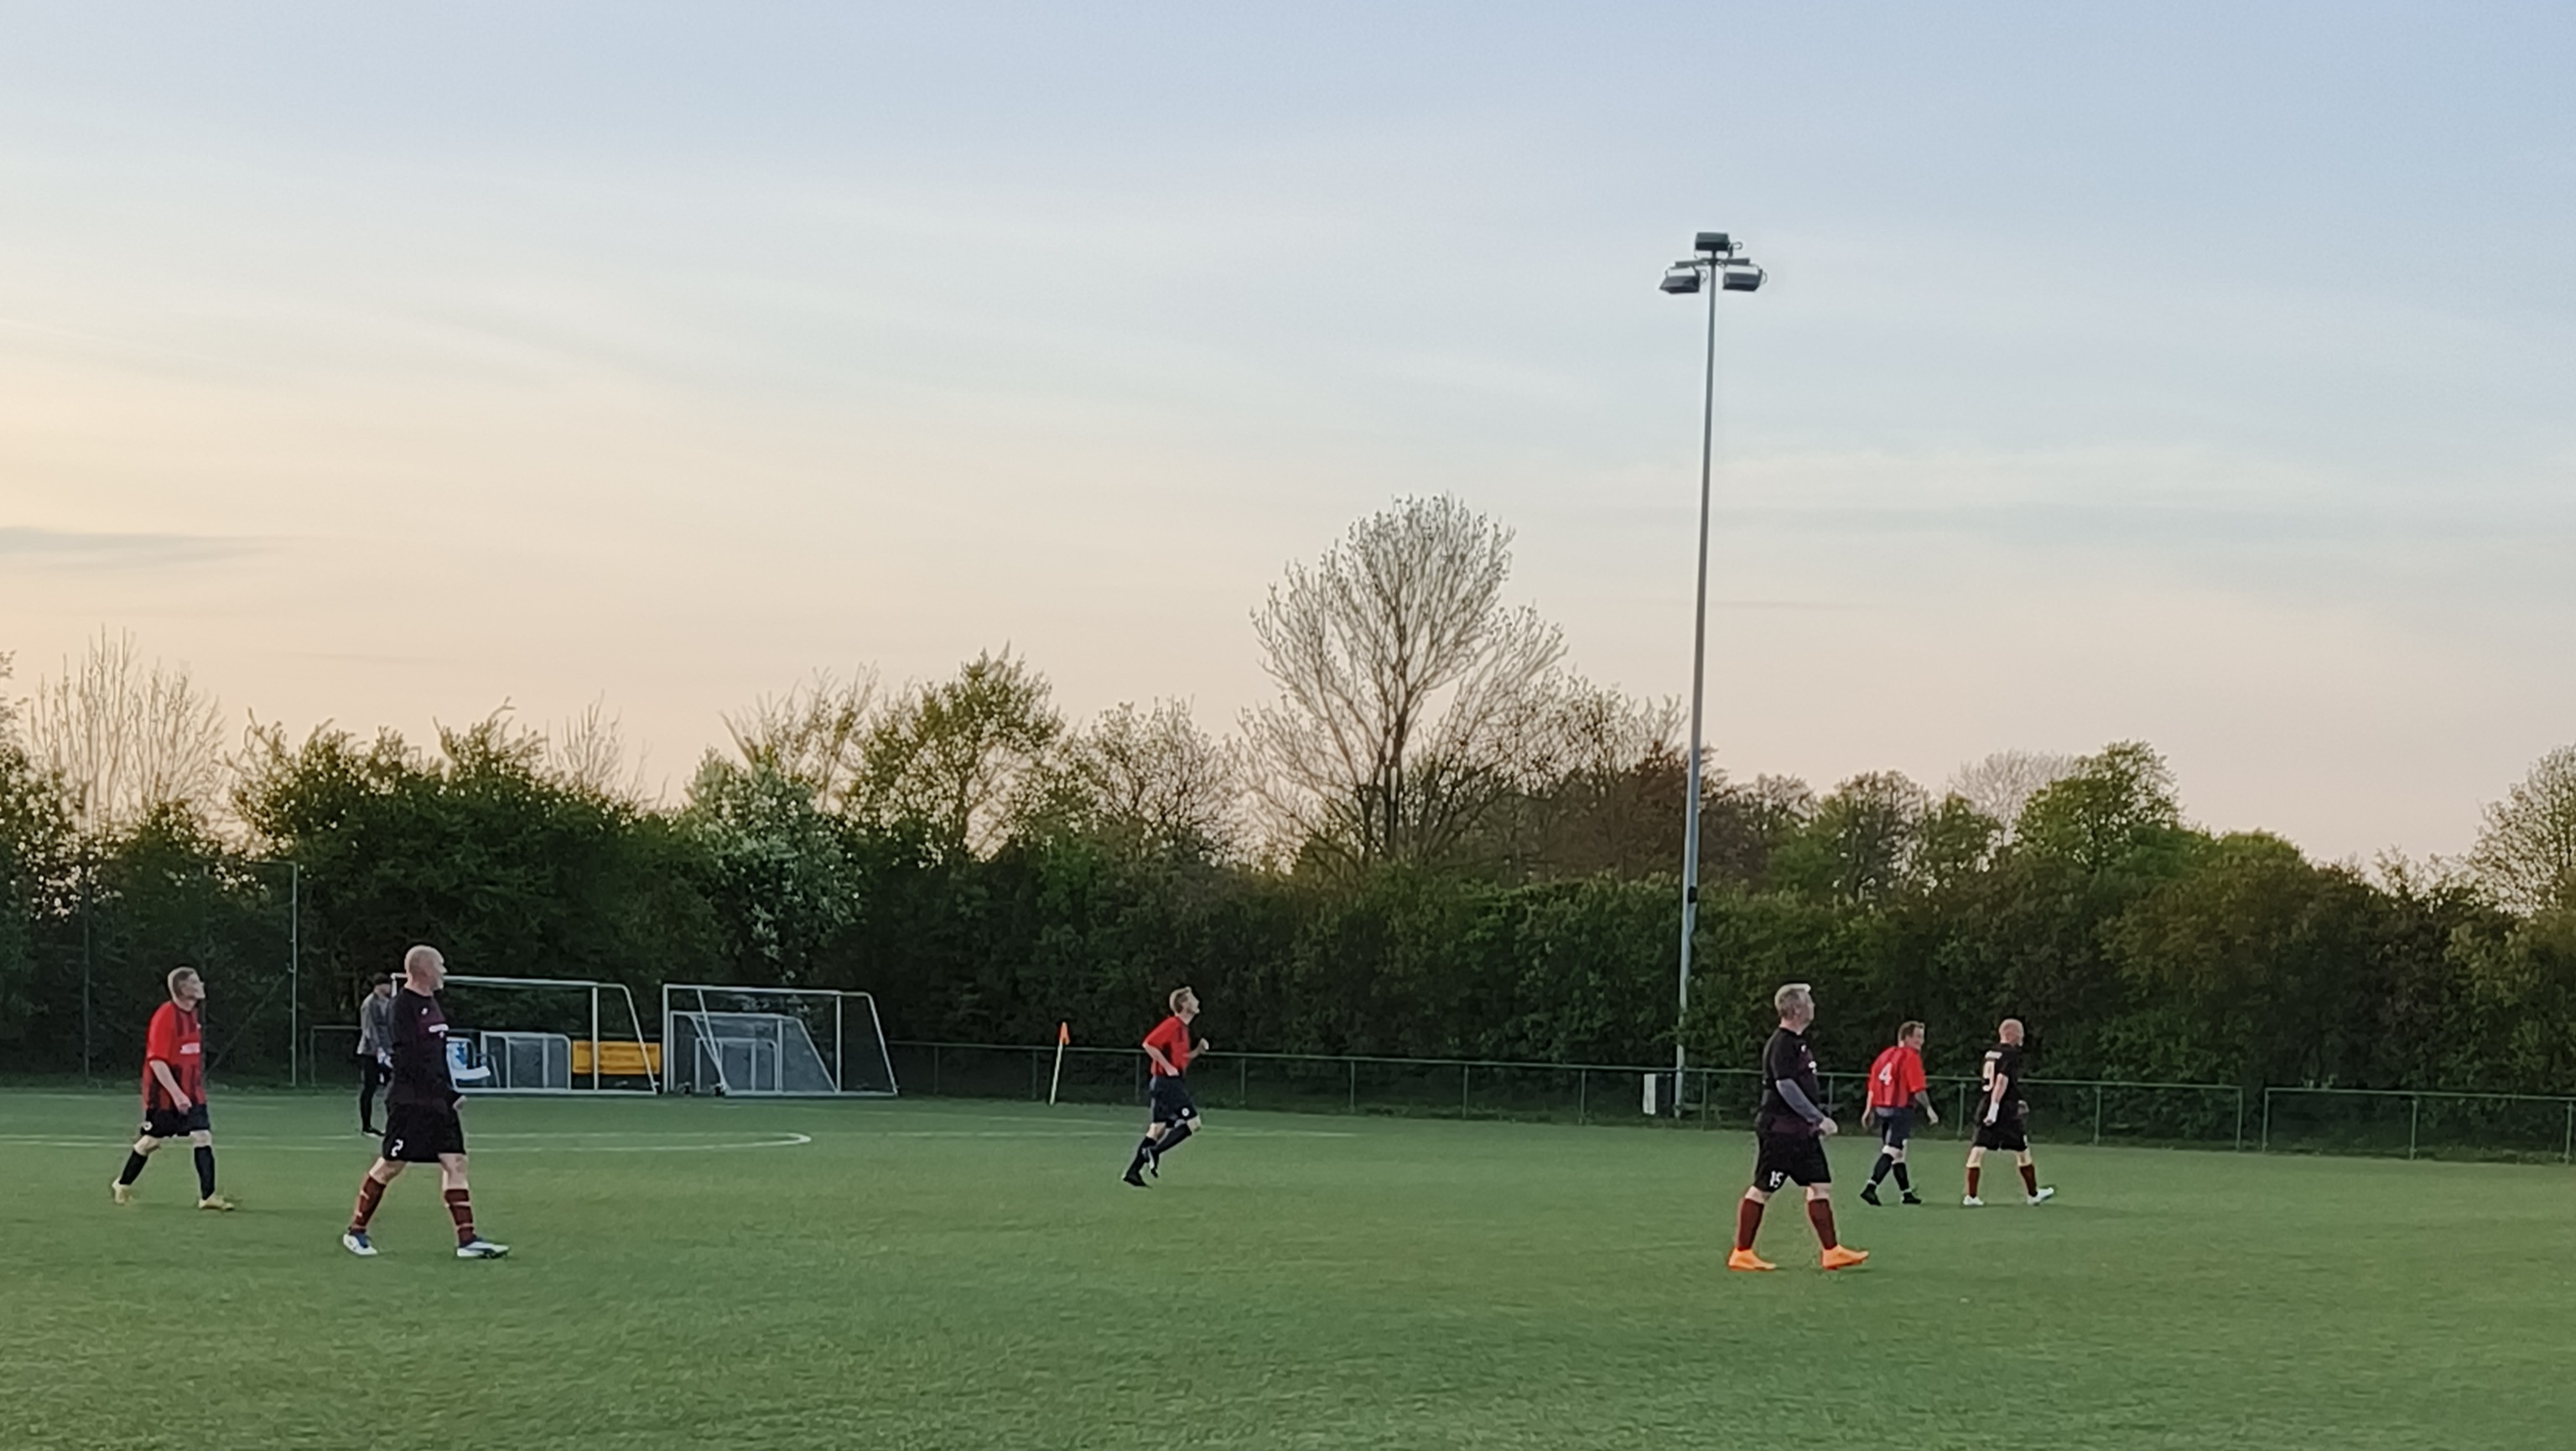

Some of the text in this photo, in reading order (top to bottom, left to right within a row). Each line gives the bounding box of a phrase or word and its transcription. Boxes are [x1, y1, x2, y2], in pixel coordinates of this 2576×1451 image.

[1878, 1062, 1893, 1085] 4
[1982, 1060, 1995, 1091] 9
[391, 1139, 403, 1157] 2
[1769, 1170, 1784, 1188] 15
